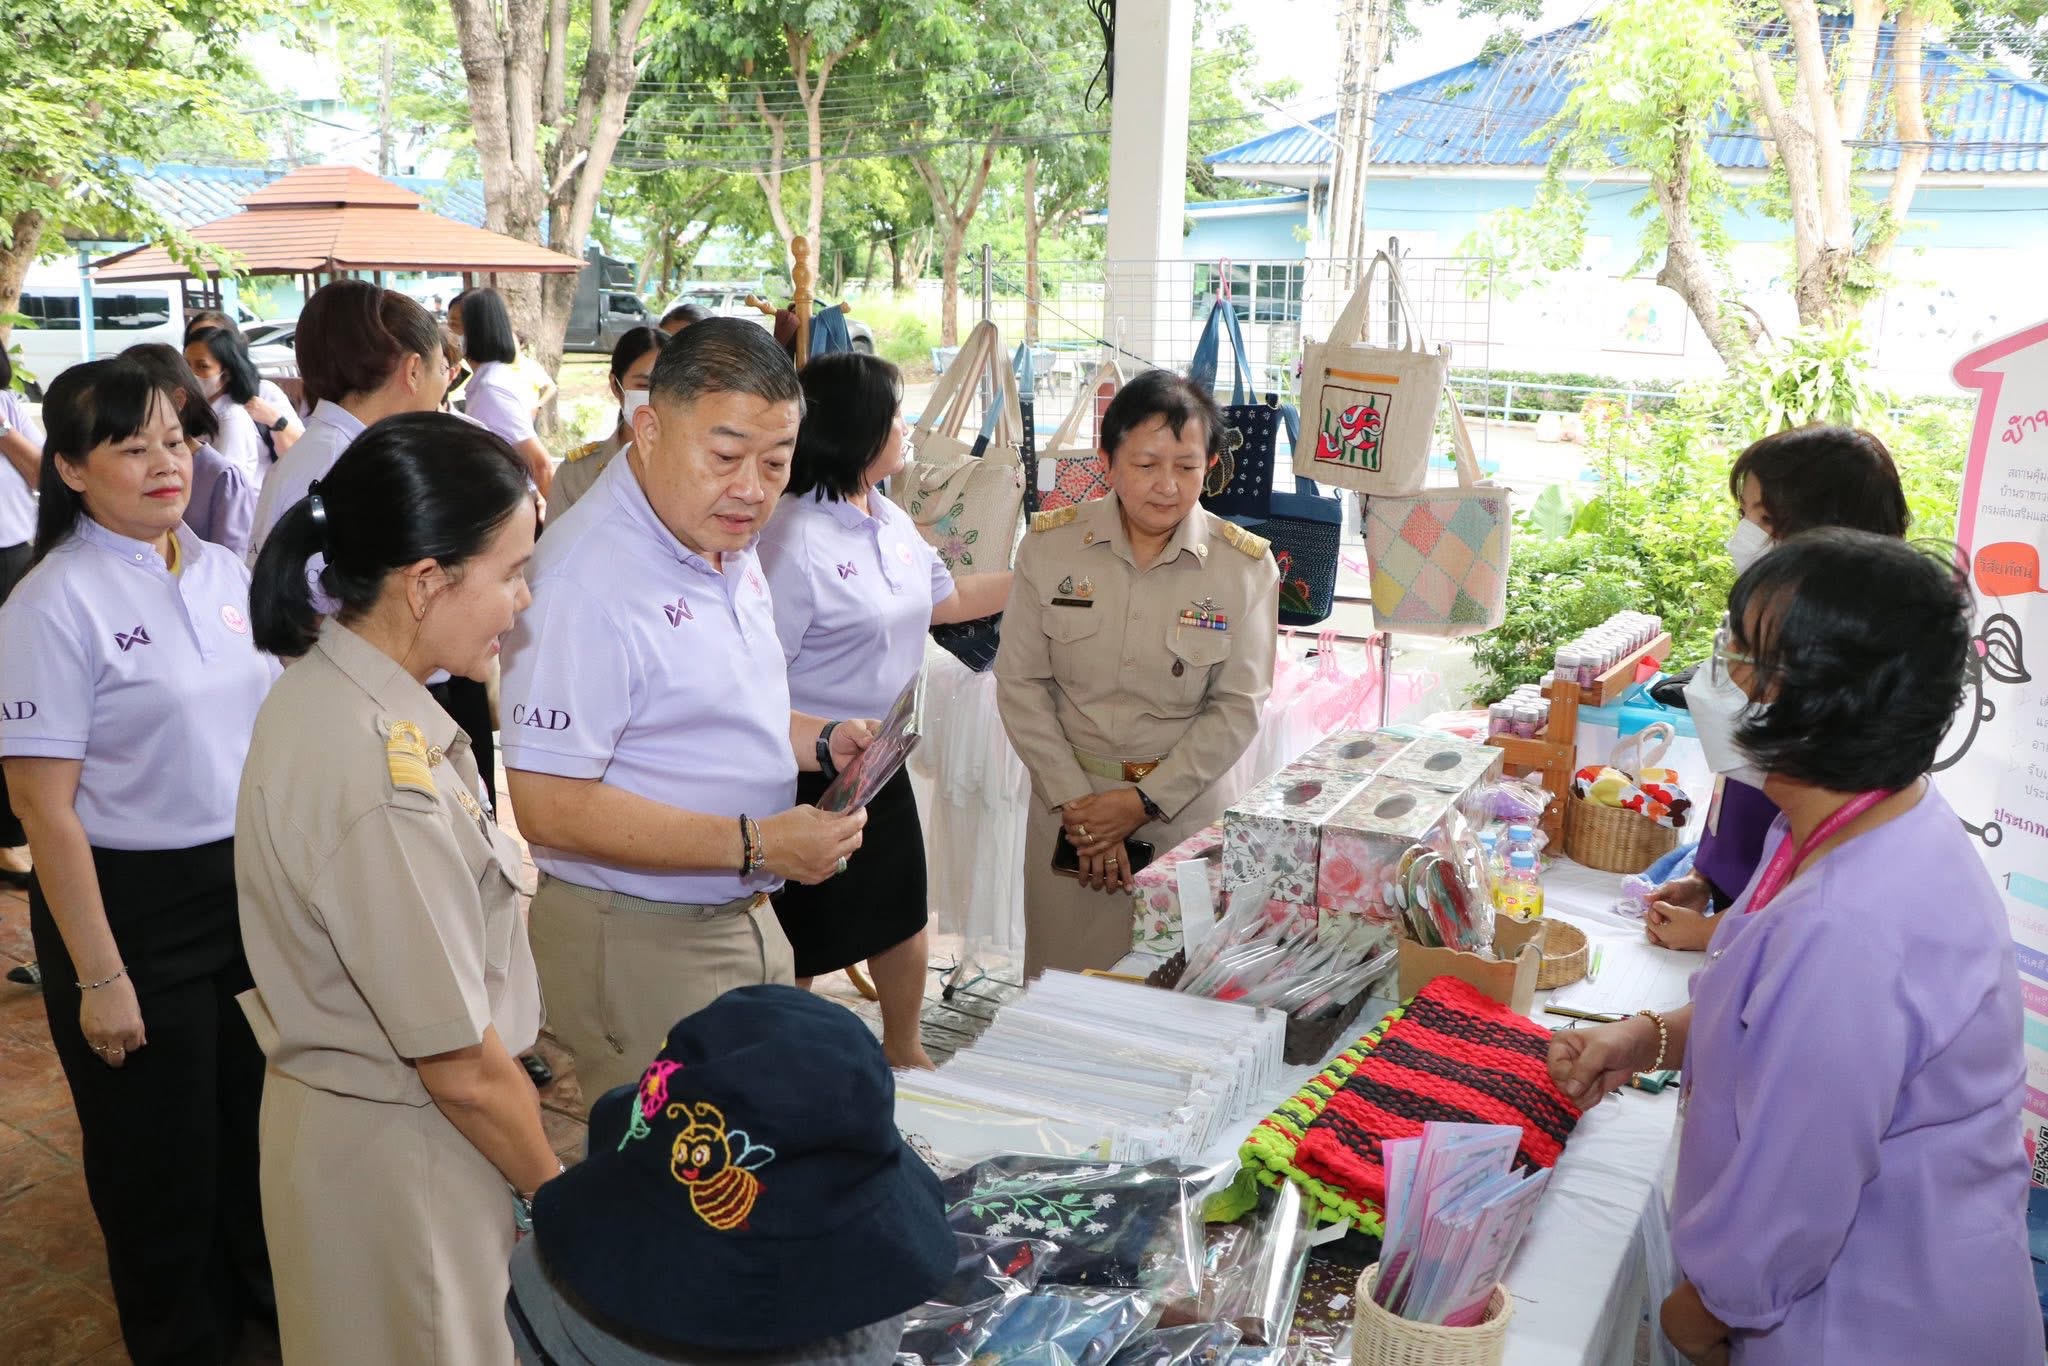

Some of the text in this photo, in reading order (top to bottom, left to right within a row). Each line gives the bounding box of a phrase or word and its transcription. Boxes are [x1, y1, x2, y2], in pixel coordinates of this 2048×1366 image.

[2008, 468, 2048, 484] สถานคุ้ม
[2000, 484, 2048, 502] บ้านราชาว
[513, 703, 571, 731] CAD
[2002, 872, 2011, 890] 1
